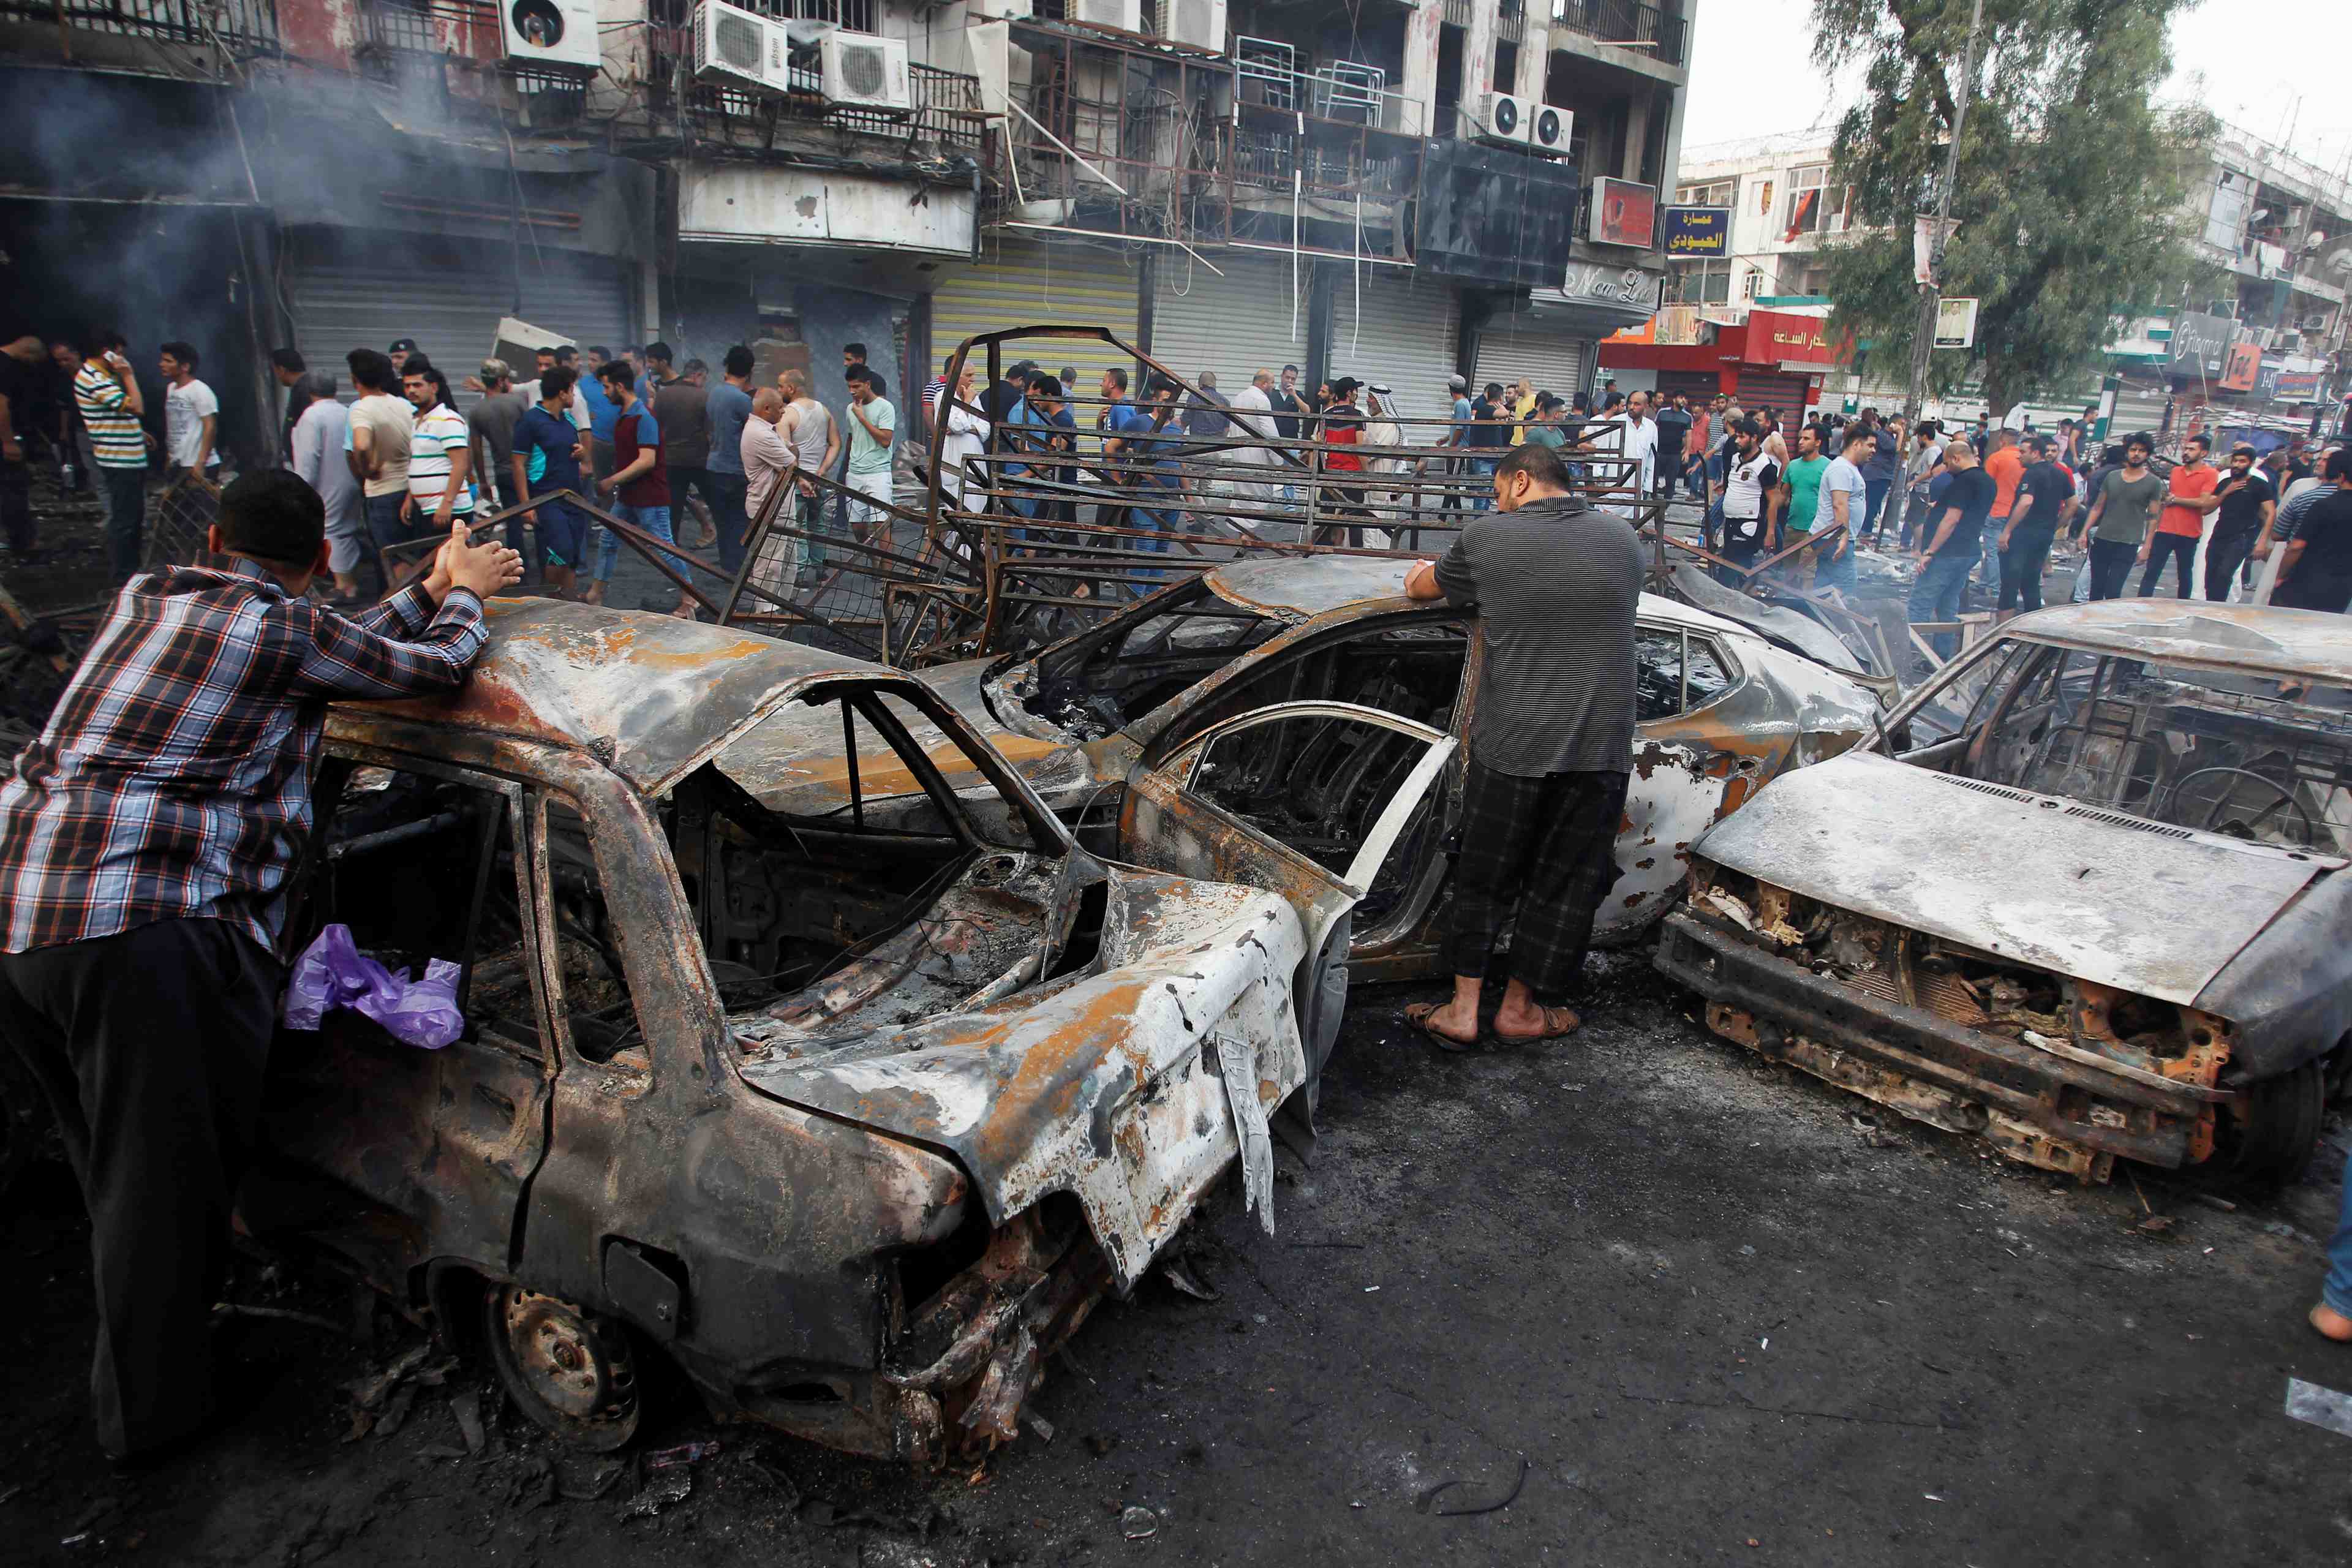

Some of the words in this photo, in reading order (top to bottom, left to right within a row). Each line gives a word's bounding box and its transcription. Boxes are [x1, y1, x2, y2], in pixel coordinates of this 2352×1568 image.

[1683, 212, 1712, 227] عمارة
[1669, 232, 1723, 254] العبودي
[1562, 265, 1617, 297] New
